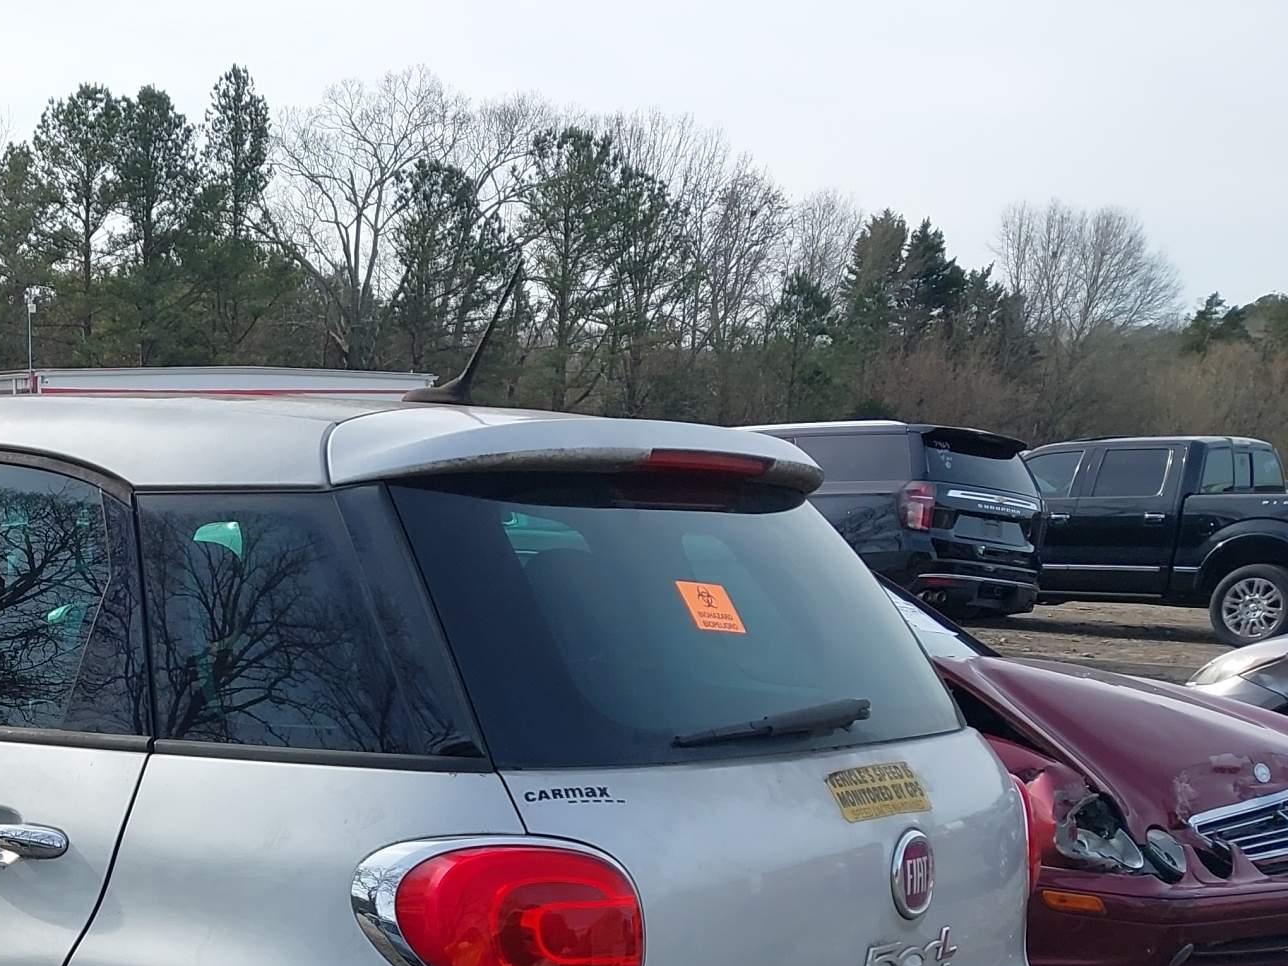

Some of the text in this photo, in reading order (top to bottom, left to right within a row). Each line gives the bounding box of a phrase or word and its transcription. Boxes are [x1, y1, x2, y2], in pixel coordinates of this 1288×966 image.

[872, 765, 905, 782] SPEED
[836, 785, 894, 809] MONITORED
[891, 783, 907, 799] BY
[904, 781, 925, 798] GPS
[906, 856, 929, 896] FIAT
